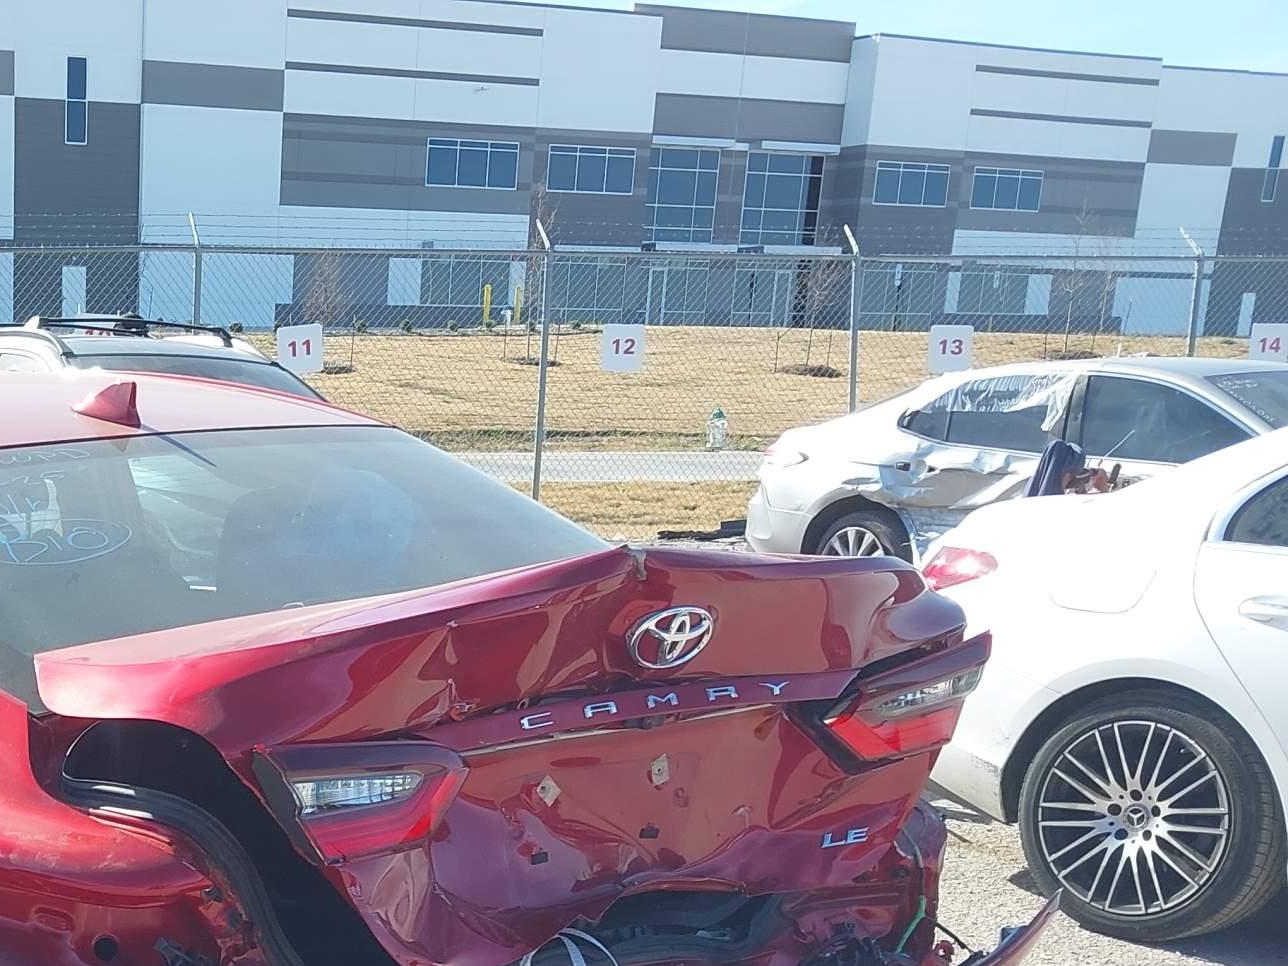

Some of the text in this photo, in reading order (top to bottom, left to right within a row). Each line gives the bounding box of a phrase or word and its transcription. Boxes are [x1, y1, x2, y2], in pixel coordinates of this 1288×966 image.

[288, 339, 311, 358] 11
[612, 338, 636, 355] 12
[939, 339, 964, 356] 13
[1259, 337, 1281, 353] 14
[520, 680, 791, 730] CAMRY
[821, 826, 870, 849] LE
